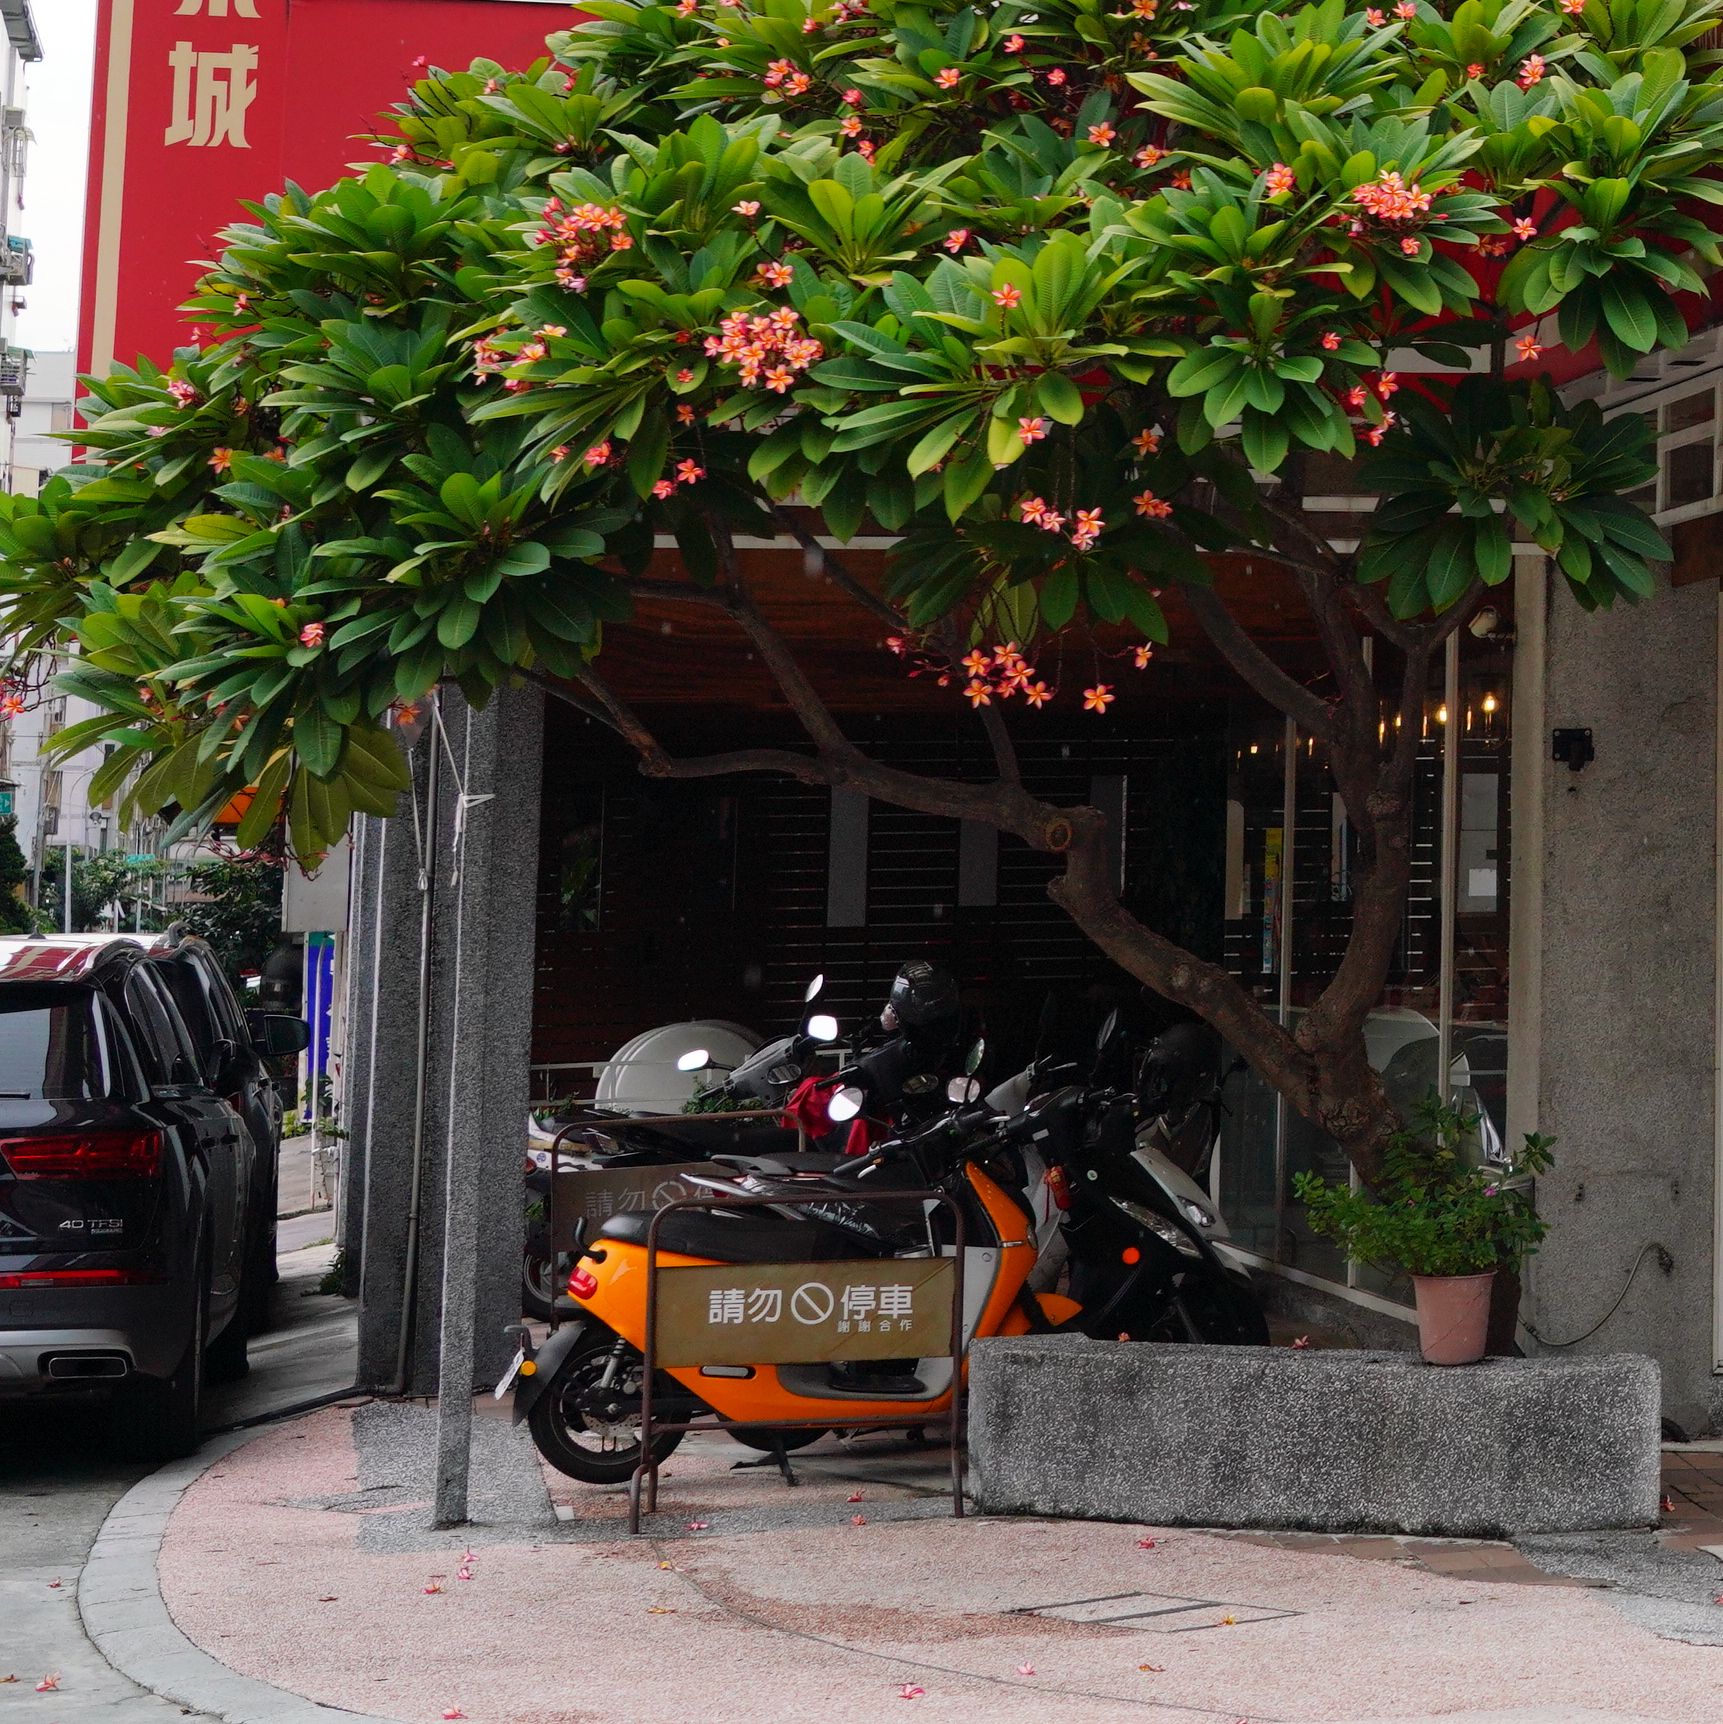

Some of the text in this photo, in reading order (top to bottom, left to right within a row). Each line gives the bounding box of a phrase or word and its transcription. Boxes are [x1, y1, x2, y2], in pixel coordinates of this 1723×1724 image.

[59, 1218, 123, 1229] 40 TFSI
[708, 1284, 914, 1325] 請勿 停車
[837, 1320, 914, 1333] 謝謝合作
